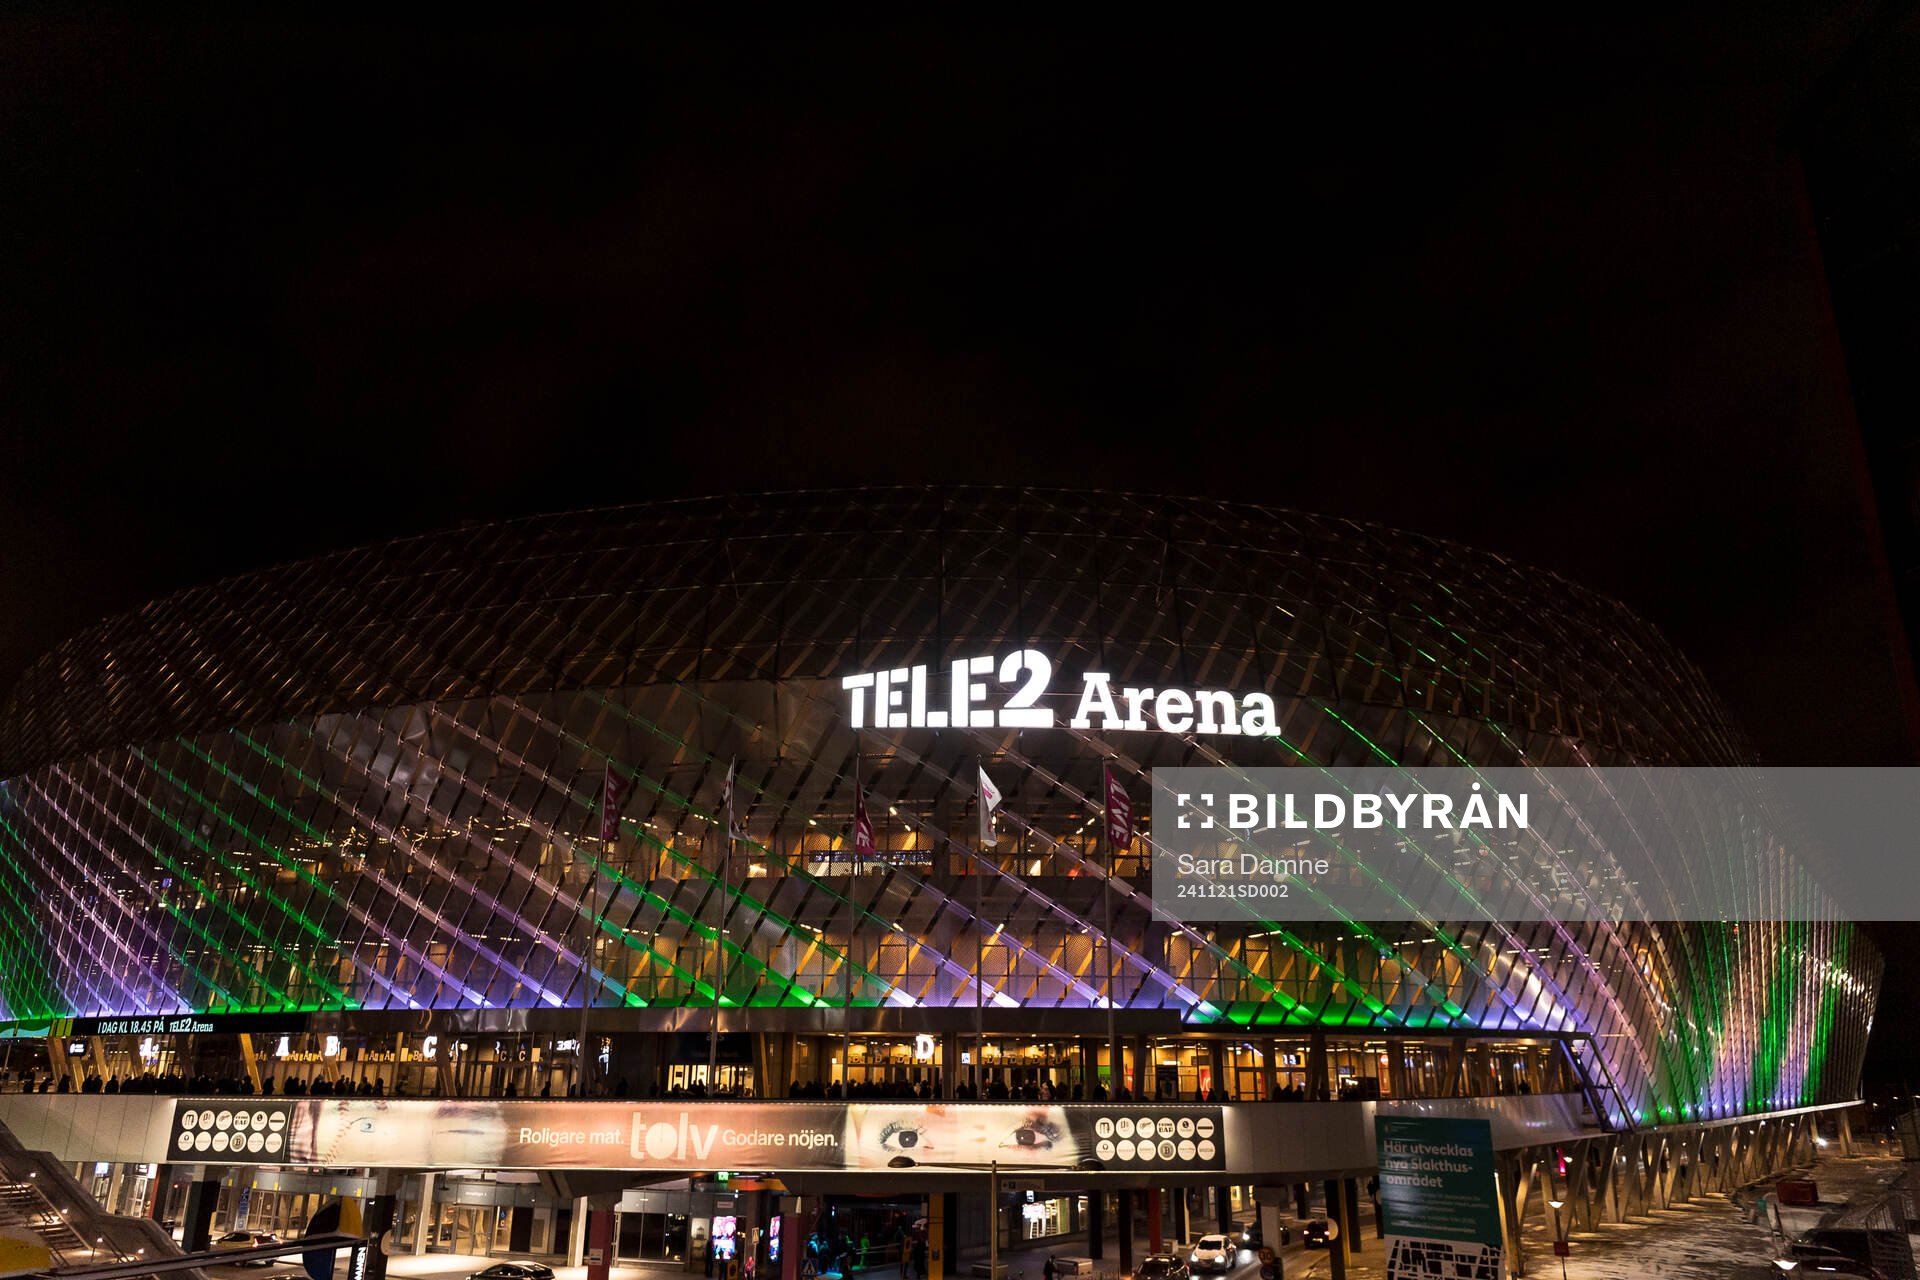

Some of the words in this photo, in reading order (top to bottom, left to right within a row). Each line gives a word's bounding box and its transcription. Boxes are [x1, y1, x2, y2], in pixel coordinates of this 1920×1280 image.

[842, 650, 1053, 728] TELE2
[1070, 672, 1281, 736] Arena
[102, 1021, 117, 1034] DAG
[118, 1020, 128, 1033] KL
[130, 1020, 151, 1033] 18.45
[153, 1016, 164, 1033] PÅ
[169, 1017, 192, 1032] TELE2
[191, 1020, 213, 1032] Arena
[276, 1037, 289, 1056] A
[423, 1036, 437, 1058] C
[916, 1035, 934, 1059] D
[520, 1127, 585, 1146] Roligare
[590, 1130, 624, 1144] mat.
[630, 1112, 719, 1160] tolv
[722, 1129, 785, 1146] Godare
[789, 1129, 838, 1149] nöjen.
[1384, 1140, 1408, 1153] Här
[1410, 1144, 1474, 1157] utvecklas
[1411, 1157, 1473, 1173] Slakthus-
[1386, 1173, 1443, 1188] området
